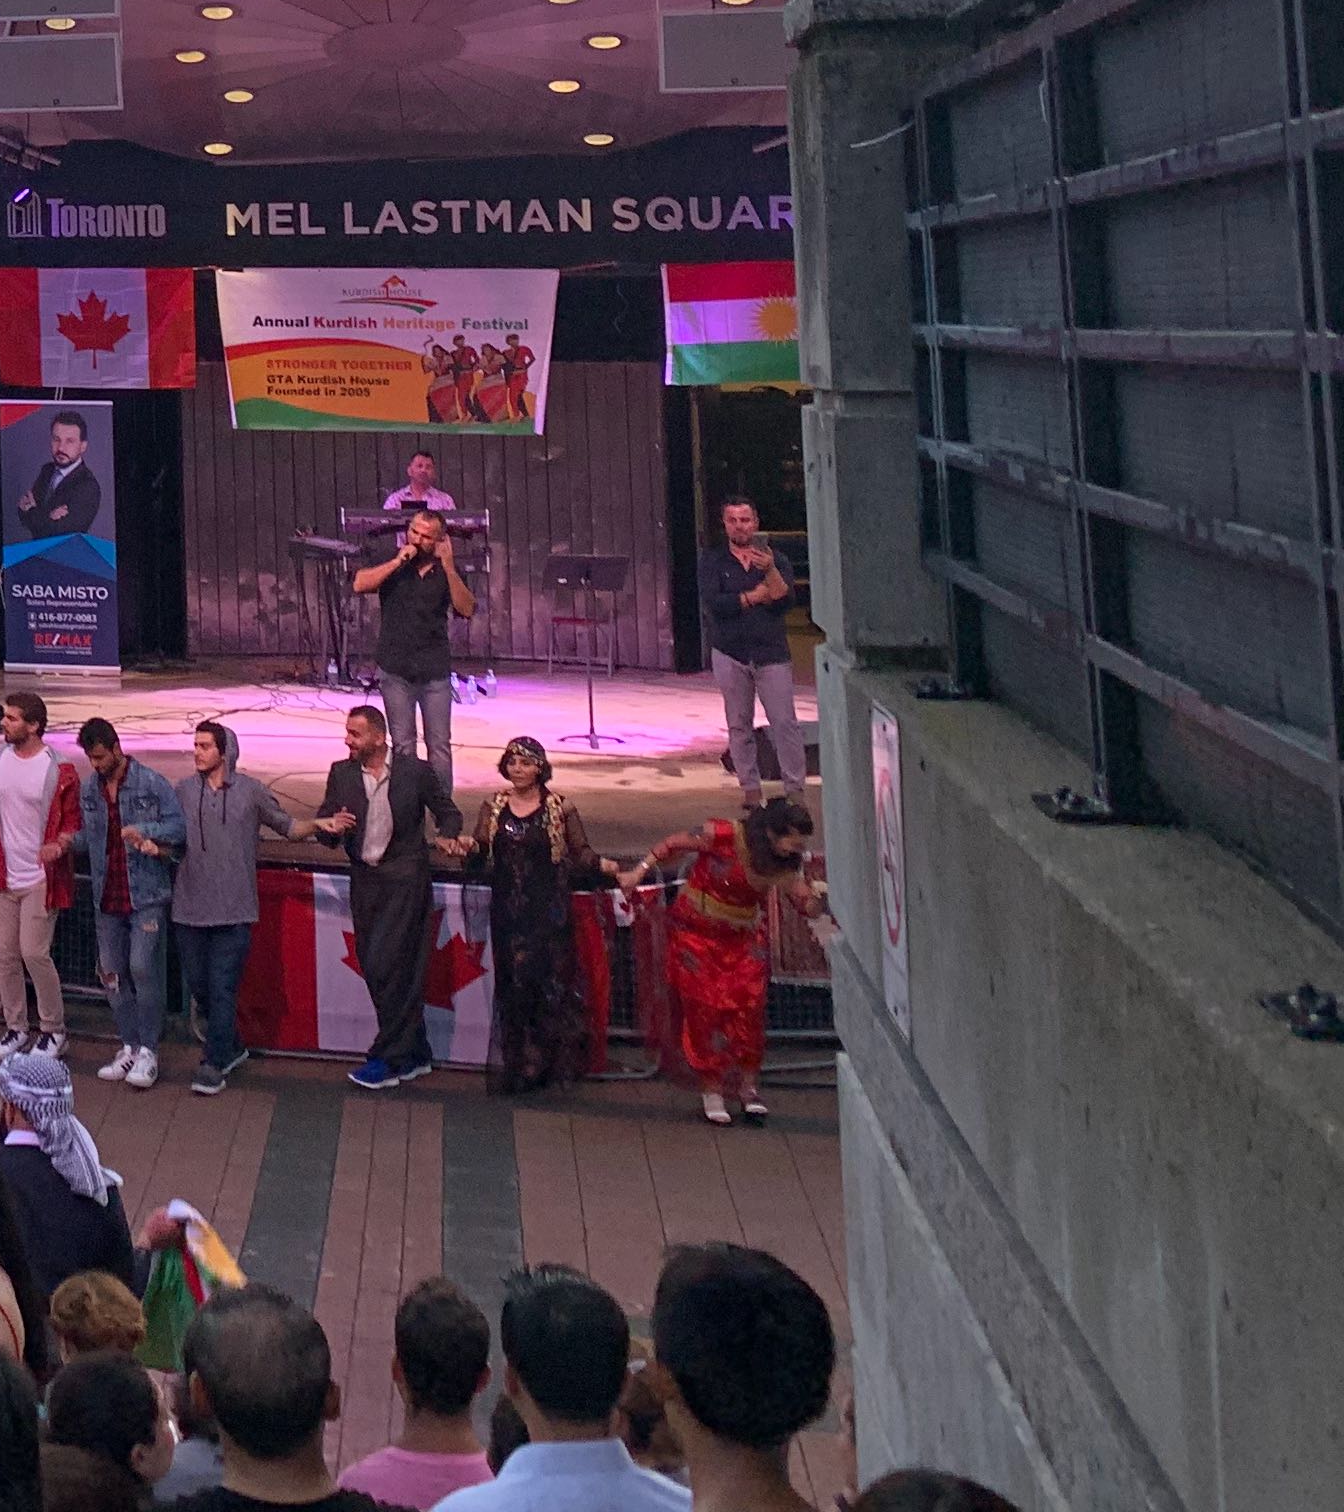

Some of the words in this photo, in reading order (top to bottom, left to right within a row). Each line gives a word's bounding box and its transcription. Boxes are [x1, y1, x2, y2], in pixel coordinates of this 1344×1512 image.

[45, 197, 167, 238] TORONTO
[225, 201, 326, 236] MEL
[343, 198, 592, 235] LASTMAN
[389, 289, 423, 297] HOUSE
[252, 316, 310, 328] Annual
[313, 316, 377, 329] Kurdish
[383, 317, 455, 332] Heritage
[461, 317, 529, 330] Festival
[266, 359, 336, 371] STRONGER
[341, 359, 412, 372] TOGETHER
[267, 375, 293, 385] GTA
[297, 375, 344, 386] Kurdish
[349, 376, 390, 387] House
[267, 386, 319, 397] Founded
[339, 388, 370, 398] 2005
[12, 584, 55, 598] SABA
[58, 585, 109, 600] MISTO
